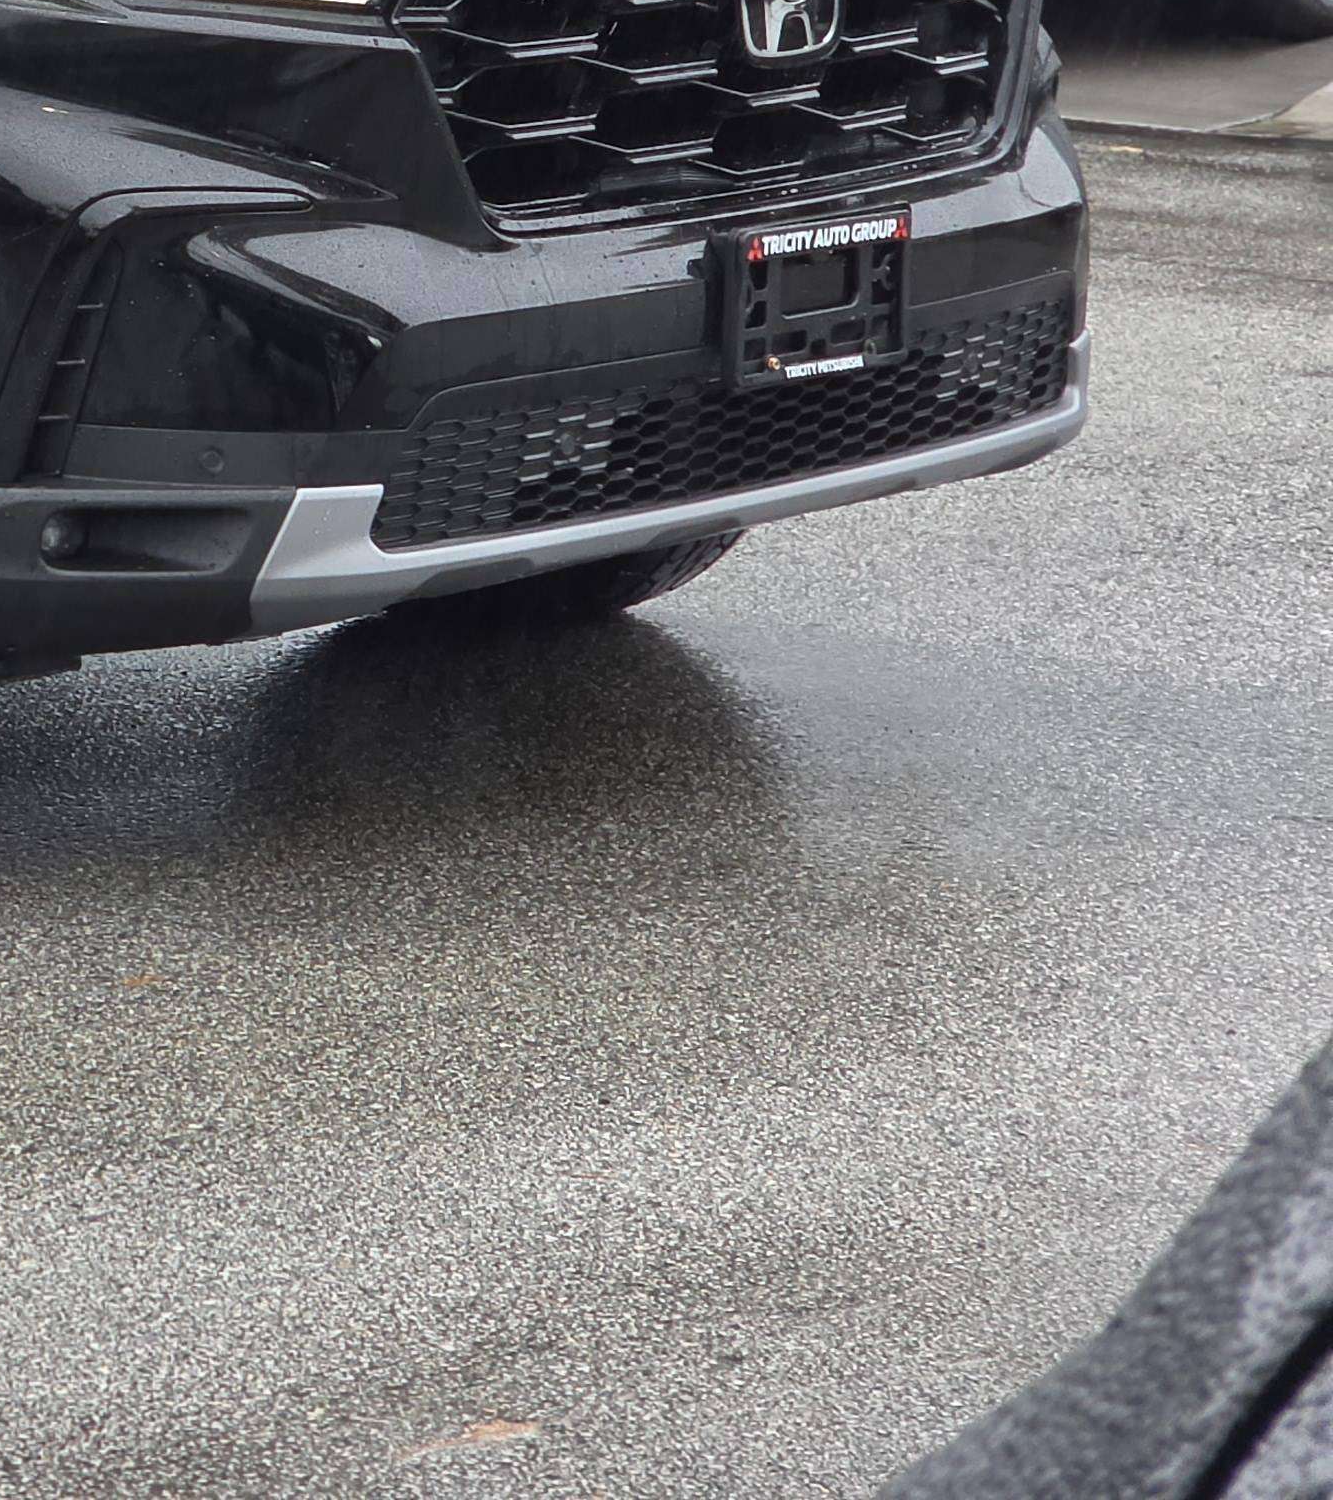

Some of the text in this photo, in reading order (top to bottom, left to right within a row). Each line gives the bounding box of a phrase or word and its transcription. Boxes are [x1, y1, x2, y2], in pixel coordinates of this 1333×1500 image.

[761, 218, 898, 256] TRICITY AUTO GROUP
